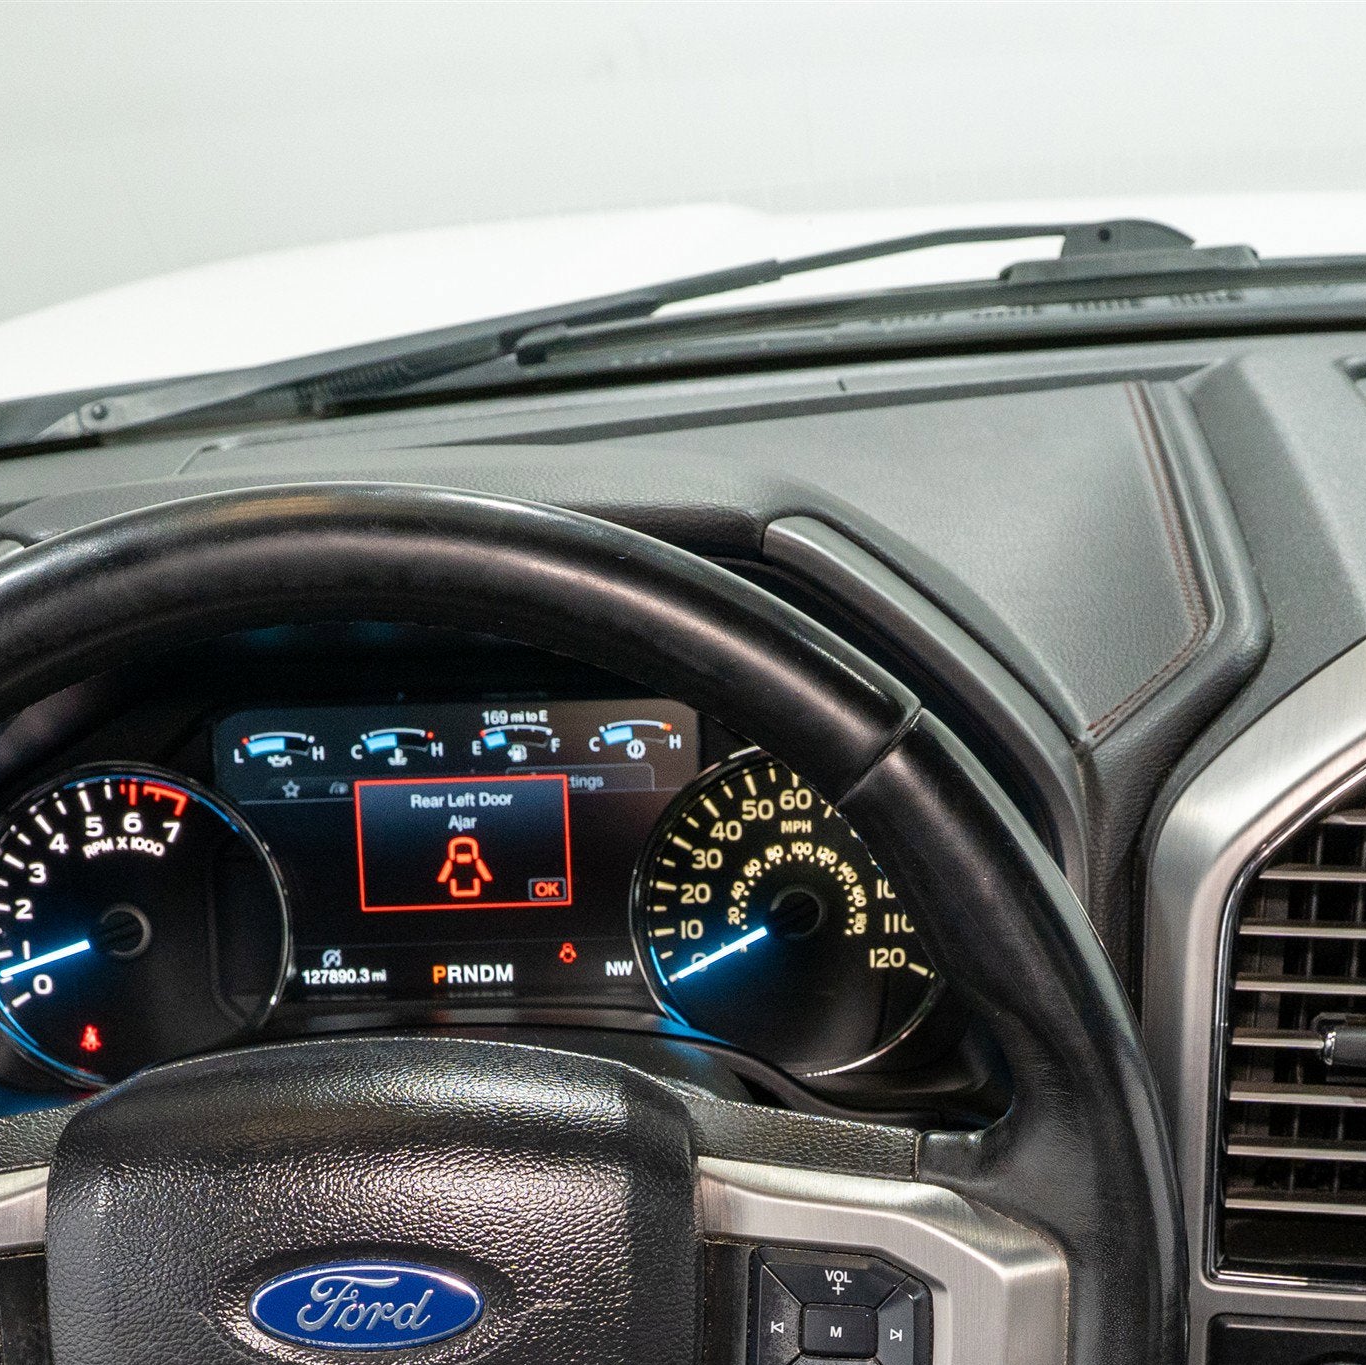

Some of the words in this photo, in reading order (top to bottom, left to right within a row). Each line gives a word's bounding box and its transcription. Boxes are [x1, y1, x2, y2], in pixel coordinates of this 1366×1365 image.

[482, 710, 508, 724] 169
[510, 711, 524, 723] mi
[525, 710, 538, 723] to
[539, 710, 548, 722] E
[430, 742, 444, 757] H
[471, 740, 482, 756] E
[550, 738, 560, 752] F
[588, 736, 600, 752] C
[669, 734, 682, 749] H
[234, 748, 244, 763] L
[311, 746, 325, 760] H
[350, 744, 363, 760] C
[570, 775, 604, 791] tings
[410, 793, 445, 808] Rear
[447, 792, 476, 808] Left
[479, 791, 513, 807] Door
[779, 788, 812, 810] 60
[742, 799, 774, 821] 50
[85, 816, 103, 838] 5
[123, 812, 142, 833] 6
[448, 815, 477, 832] Ajar
[710, 820, 743, 842] 40
[781, 820, 812, 834] MPH
[162, 822, 181, 843] 7
[49, 833, 69, 854] 4
[83, 839, 114, 859] RPM
[117, 837, 129, 850] X
[131, 836, 165, 858] 1000
[765, 845, 784, 860] 80
[791, 842, 813, 855] 100
[692, 849, 723, 869] 30
[816, 846, 838, 864] 120
[29, 863, 47, 884] 3
[743, 859, 762, 878] 60
[838, 861, 858, 884] 140
[535, 882, 560, 897] OK
[680, 883, 711, 904] 20
[731, 881, 746, 900] 40
[852, 884, 867, 908] 160
[15, 900, 33, 919] 2
[728, 906, 741, 925] 20
[680, 919, 703, 940] 10
[853, 913, 867, 935] 180
[869, 948, 906, 968] 120
[302, 968, 370, 984] 127890.3
[372, 968, 386, 982] mi
[605, 961, 633, 977] NW
[33, 975, 53, 994] 0
[825, 1269, 853, 1284] VOL
[296, 1276, 434, 1332] Ford
[830, 1326, 842, 1338] M
